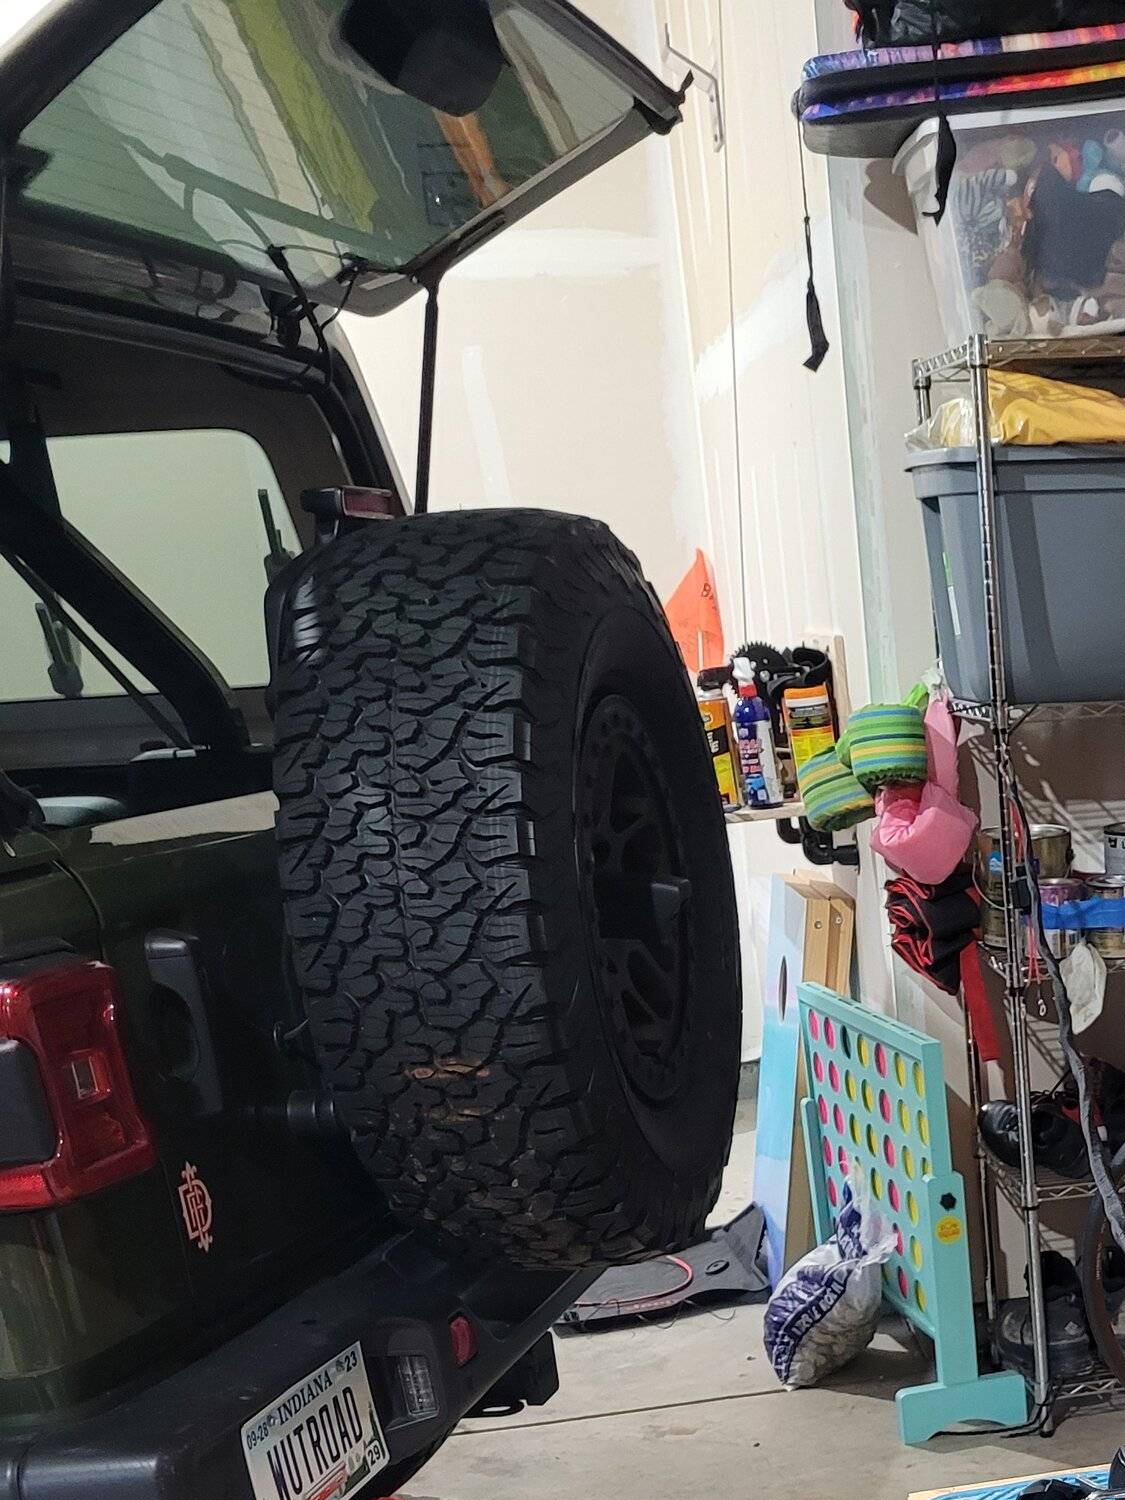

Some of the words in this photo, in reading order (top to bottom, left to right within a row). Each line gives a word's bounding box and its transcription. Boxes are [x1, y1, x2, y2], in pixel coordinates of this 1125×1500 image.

[277, 1370, 332, 1426] INDIANA
[344, 1350, 358, 1373] 23
[367, 1445, 381, 1465] 29
